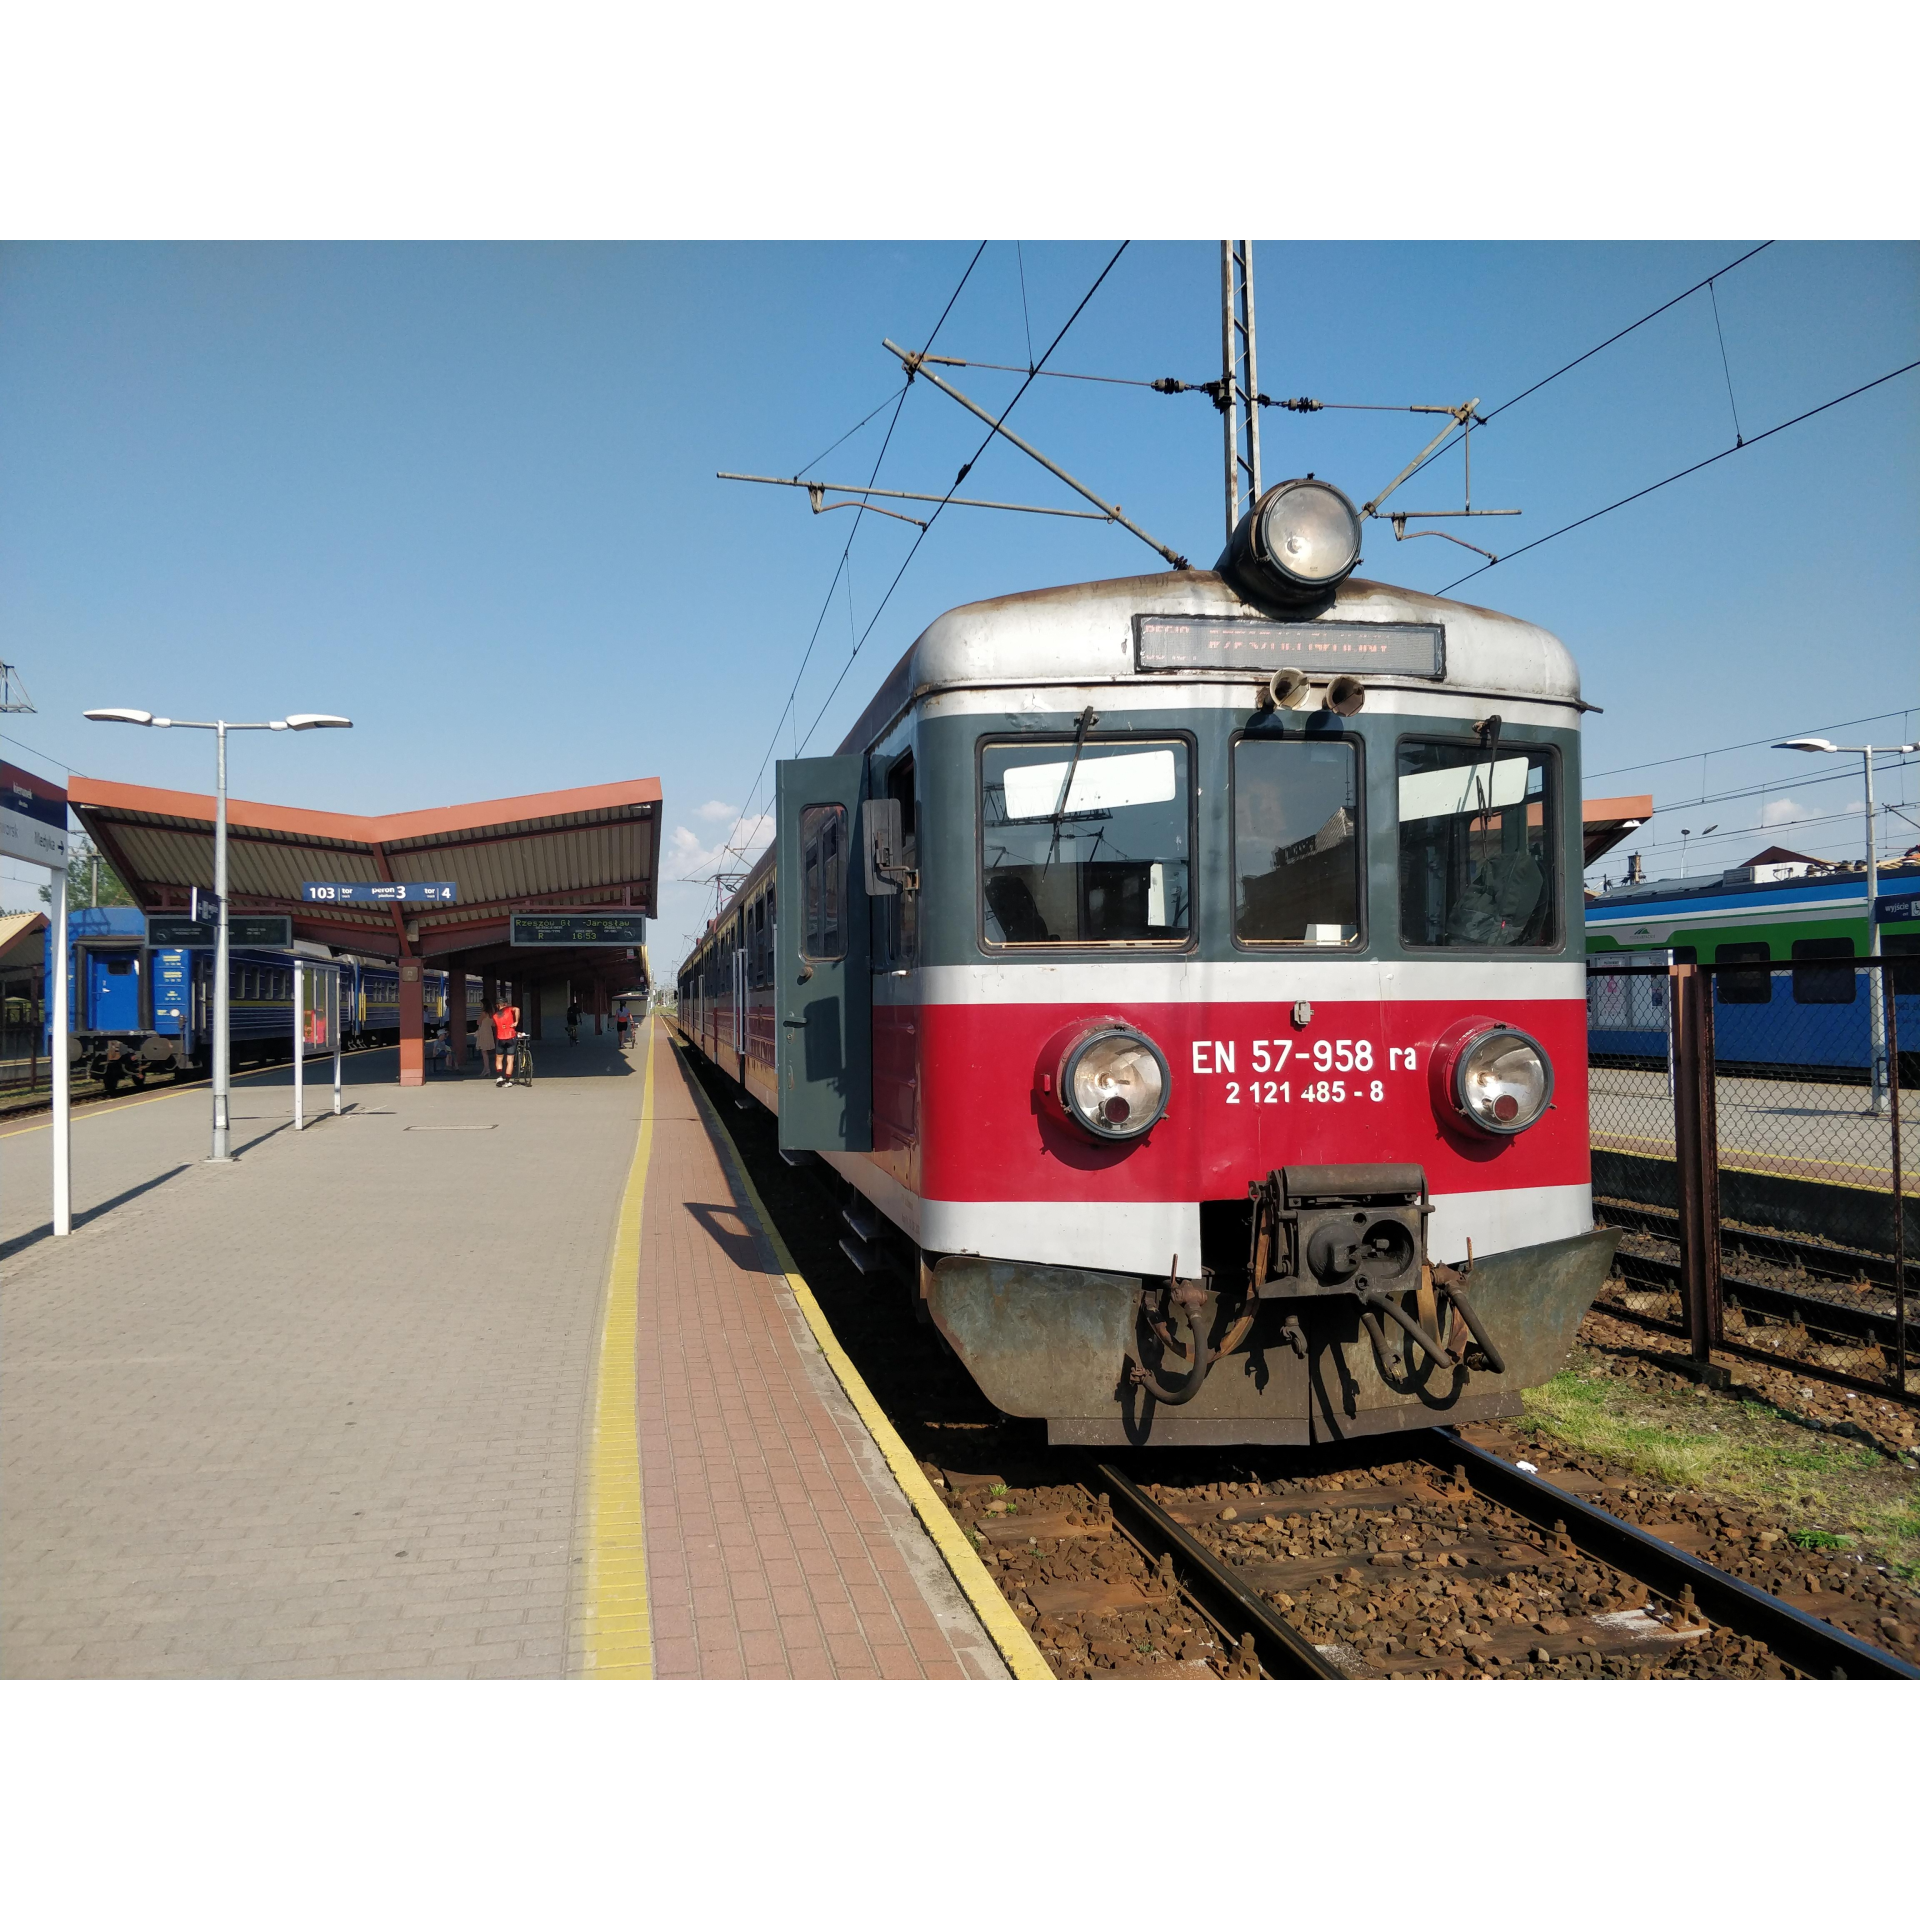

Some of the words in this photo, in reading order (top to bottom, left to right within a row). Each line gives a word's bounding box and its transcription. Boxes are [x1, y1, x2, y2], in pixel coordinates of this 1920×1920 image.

[309, 887, 335, 899] 103
[341, 887, 353, 895] tor
[371, 887, 395, 895] peron
[396, 885, 406, 899] 3
[424, 887, 435, 895] tor
[441, 887, 451, 899] 4
[1885, 902, 1909, 913] wyjście
[516, 918, 554, 928] Rzeszów
[538, 932, 544, 940] R
[1192, 1041, 1235, 1073] EN
[1251, 1040, 1374, 1072] 57-958
[1389, 1047, 1417, 1070] ra
[1225, 1082, 1241, 1103] 2
[1249, 1081, 1290, 1103] 121
[1300, 1081, 1346, 1103] 485
[1370, 1080, 1384, 1102] 8
